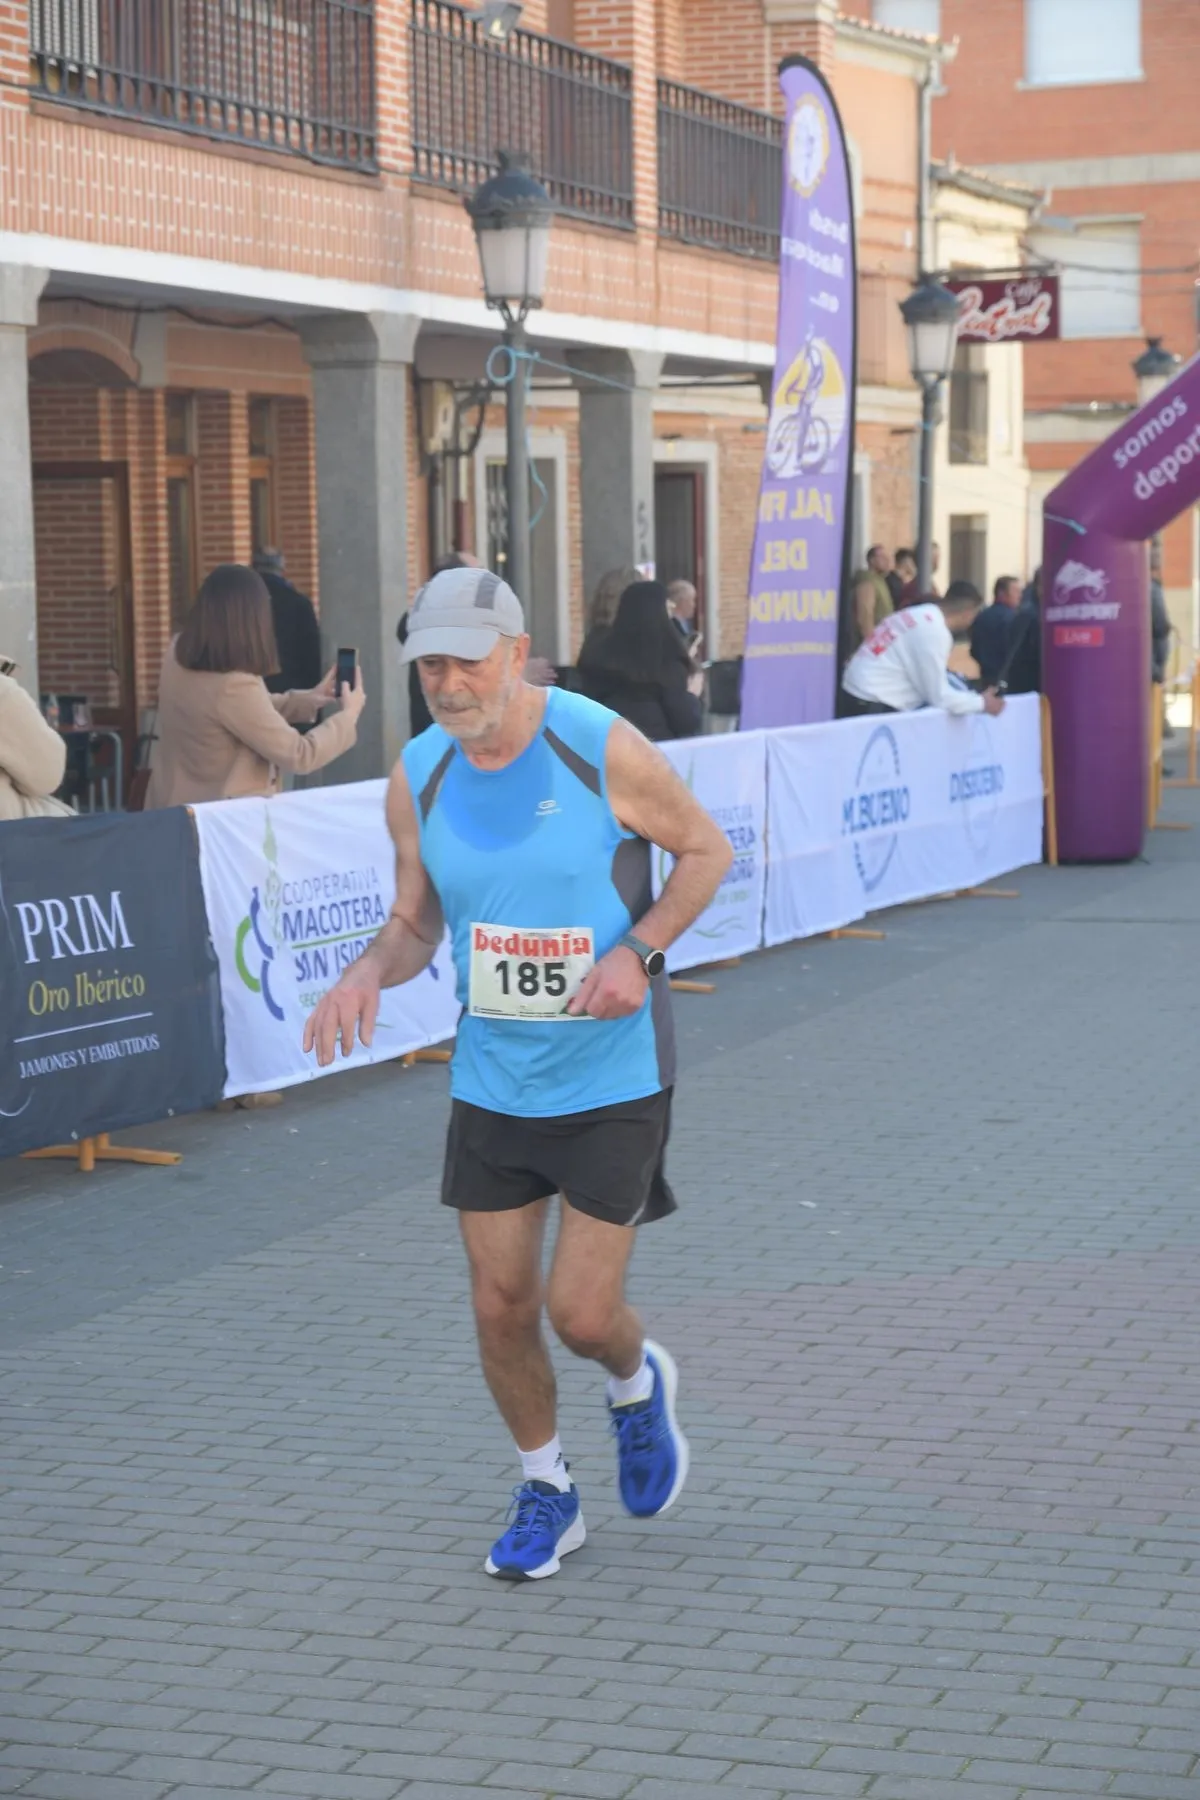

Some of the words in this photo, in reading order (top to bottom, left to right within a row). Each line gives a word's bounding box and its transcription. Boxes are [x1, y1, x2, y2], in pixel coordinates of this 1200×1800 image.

[1113, 394, 1188, 469] somos
[282, 866, 380, 906] COOPERATIVA
[13, 890, 136, 965] PRIM
[281, 894, 386, 942] MACOTERA
[474, 927, 591, 957] bedunia
[28, 980, 70, 1016] Oro
[75, 970, 146, 1008] Ibérico
[495, 960, 567, 997] 185
[18, 1048, 77, 1080] JAMONES
[77, 1048, 88, 1065] Y
[88, 1034, 160, 1064] EMBUTIDOS
